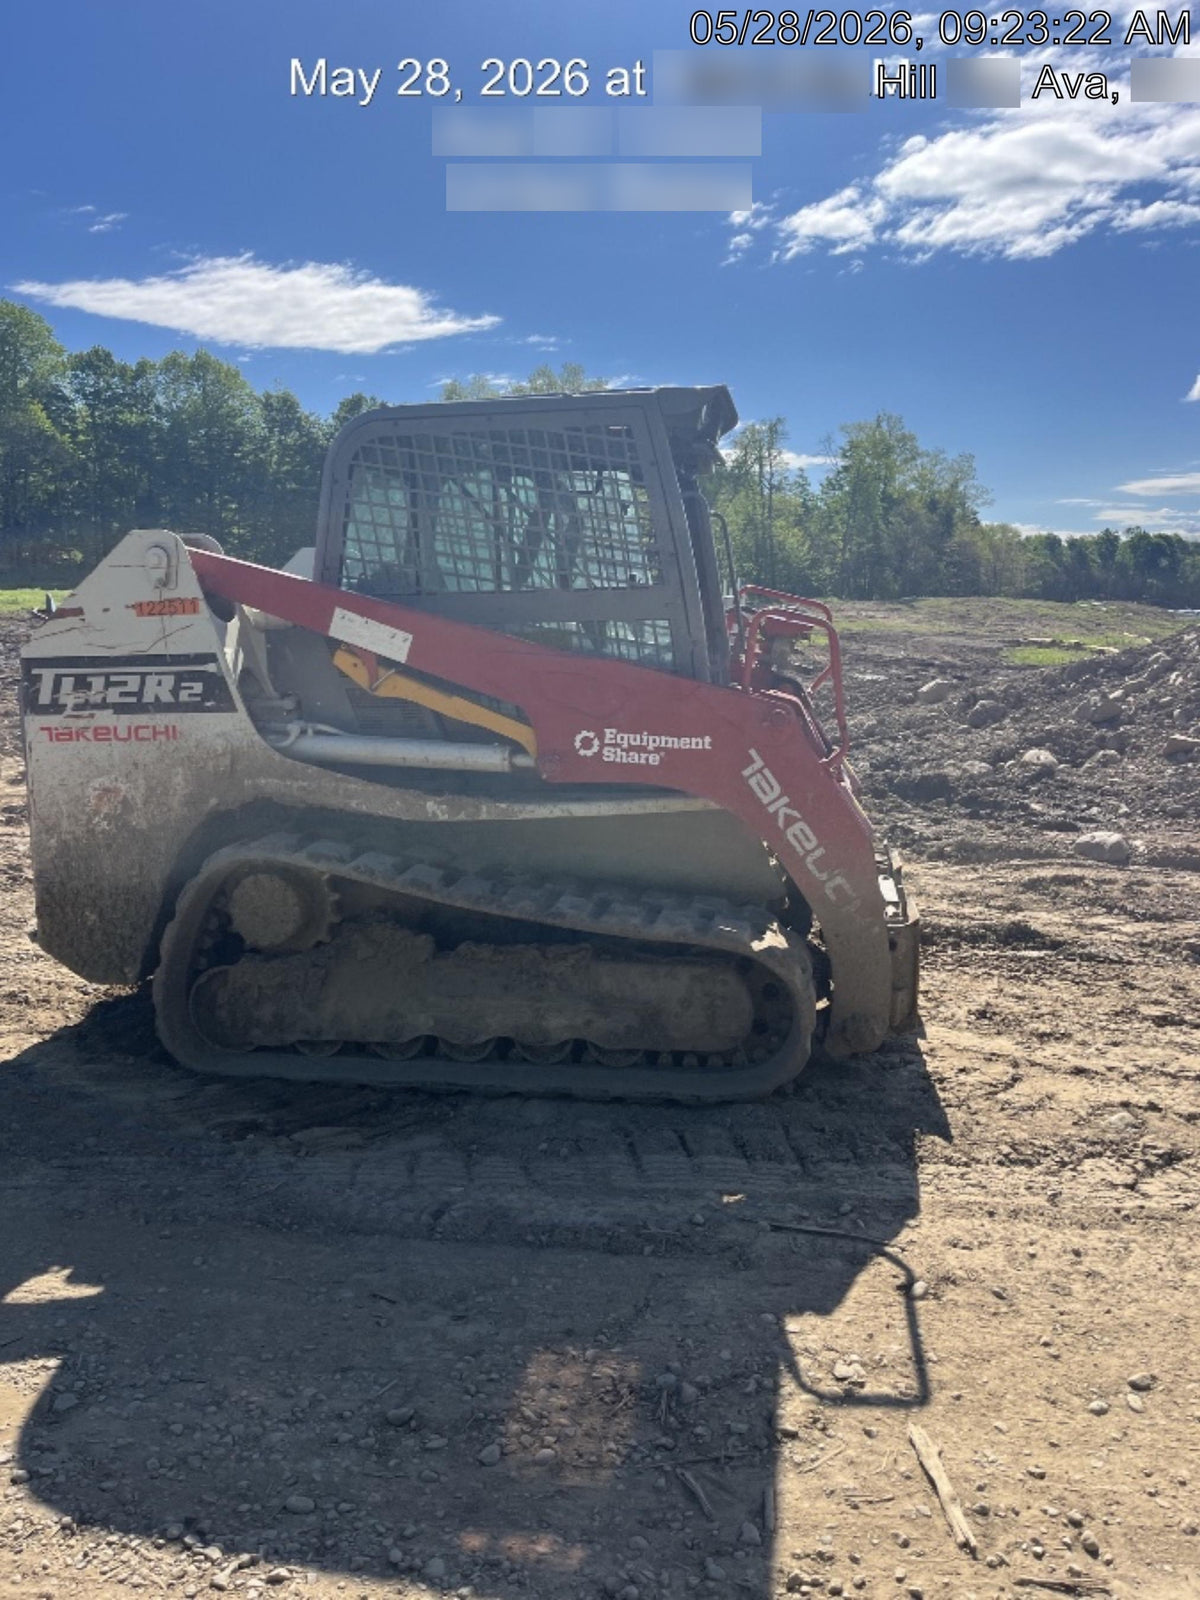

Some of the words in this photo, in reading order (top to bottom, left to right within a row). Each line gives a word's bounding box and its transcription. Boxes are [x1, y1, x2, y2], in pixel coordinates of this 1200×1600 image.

[137, 599, 198, 617] 122511
[603, 728, 713, 750] Equipment
[602, 746, 660, 766] Share
